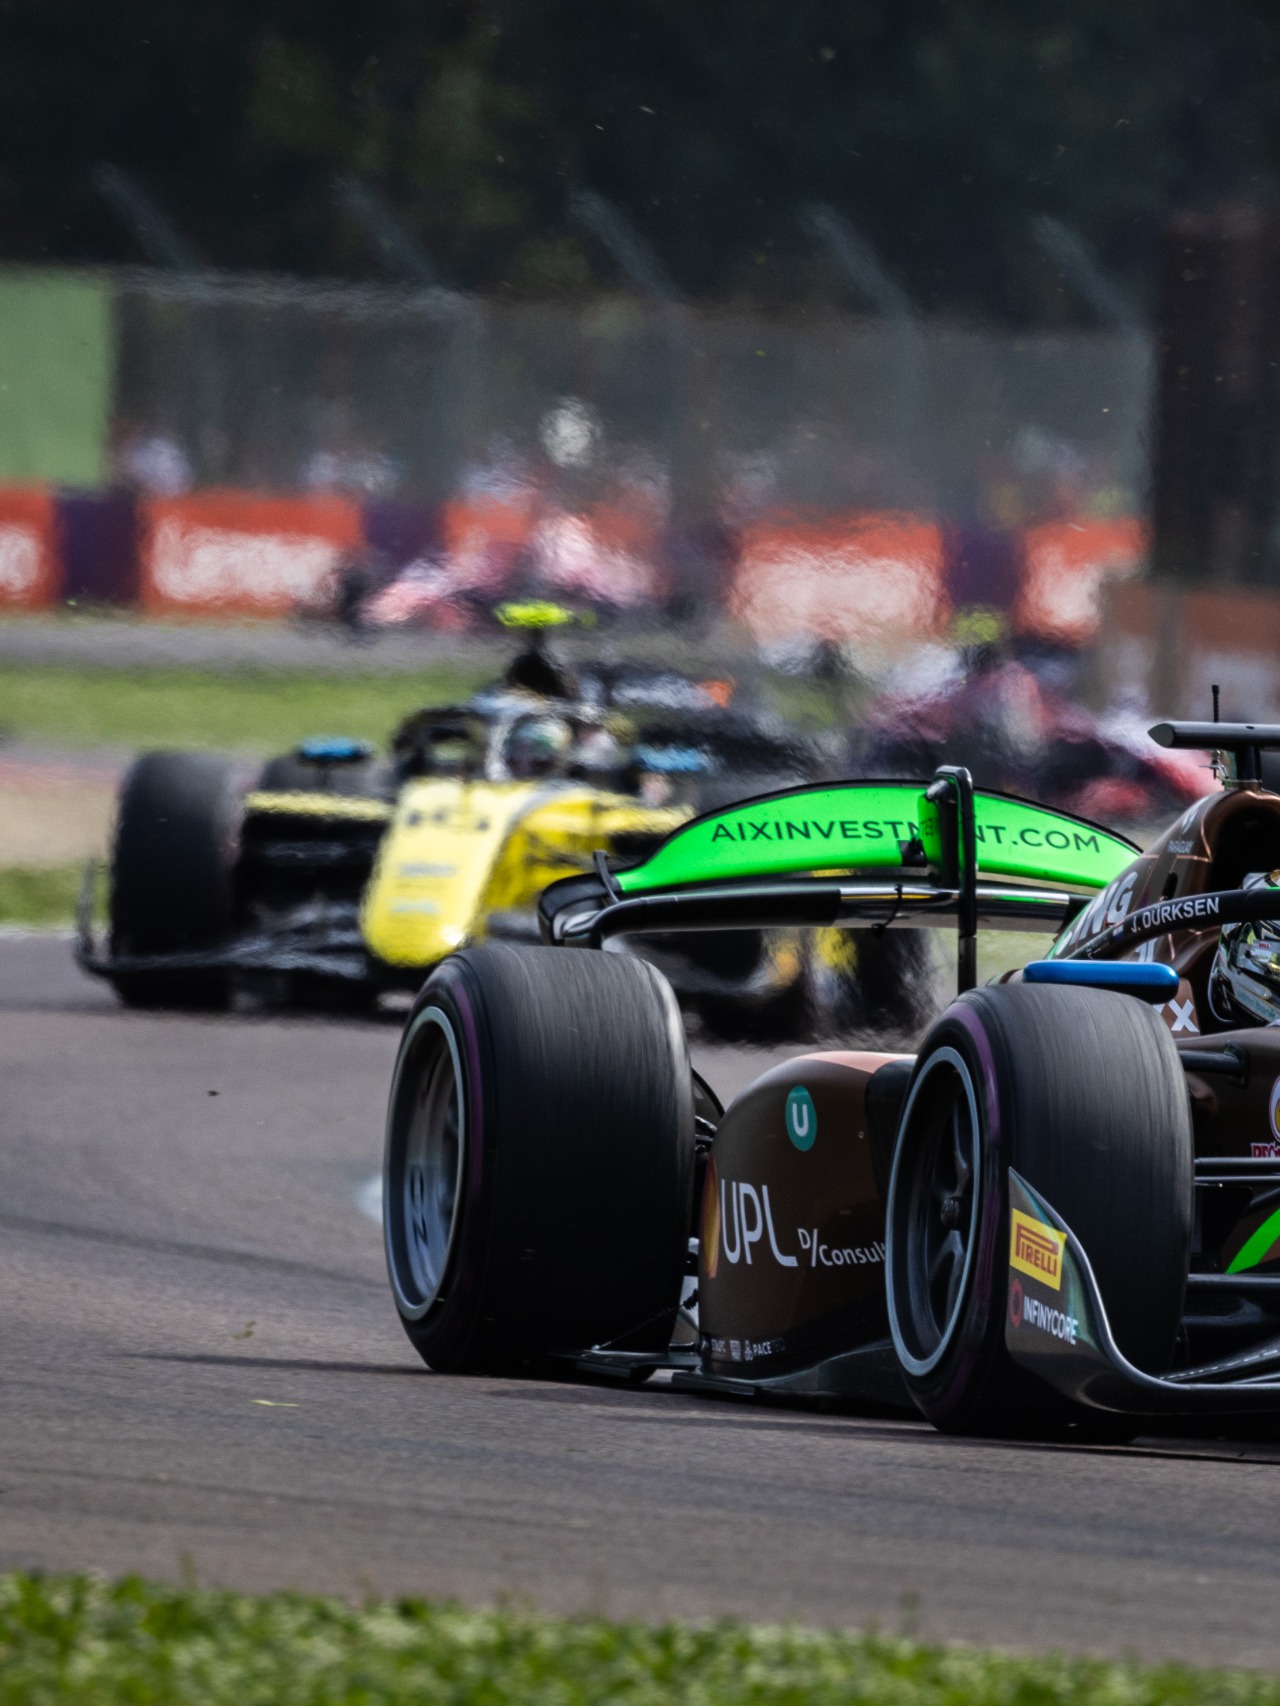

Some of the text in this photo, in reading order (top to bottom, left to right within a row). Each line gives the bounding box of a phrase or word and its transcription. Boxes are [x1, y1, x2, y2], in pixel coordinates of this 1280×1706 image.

[711, 820, 1101, 854] AIXINVESTNT.COM
[721, 1178, 886, 1267] UPL D/Consul
[1015, 1222, 1060, 1277] PIRELLI
[1023, 1294, 1079, 1346] INFINYCORE
